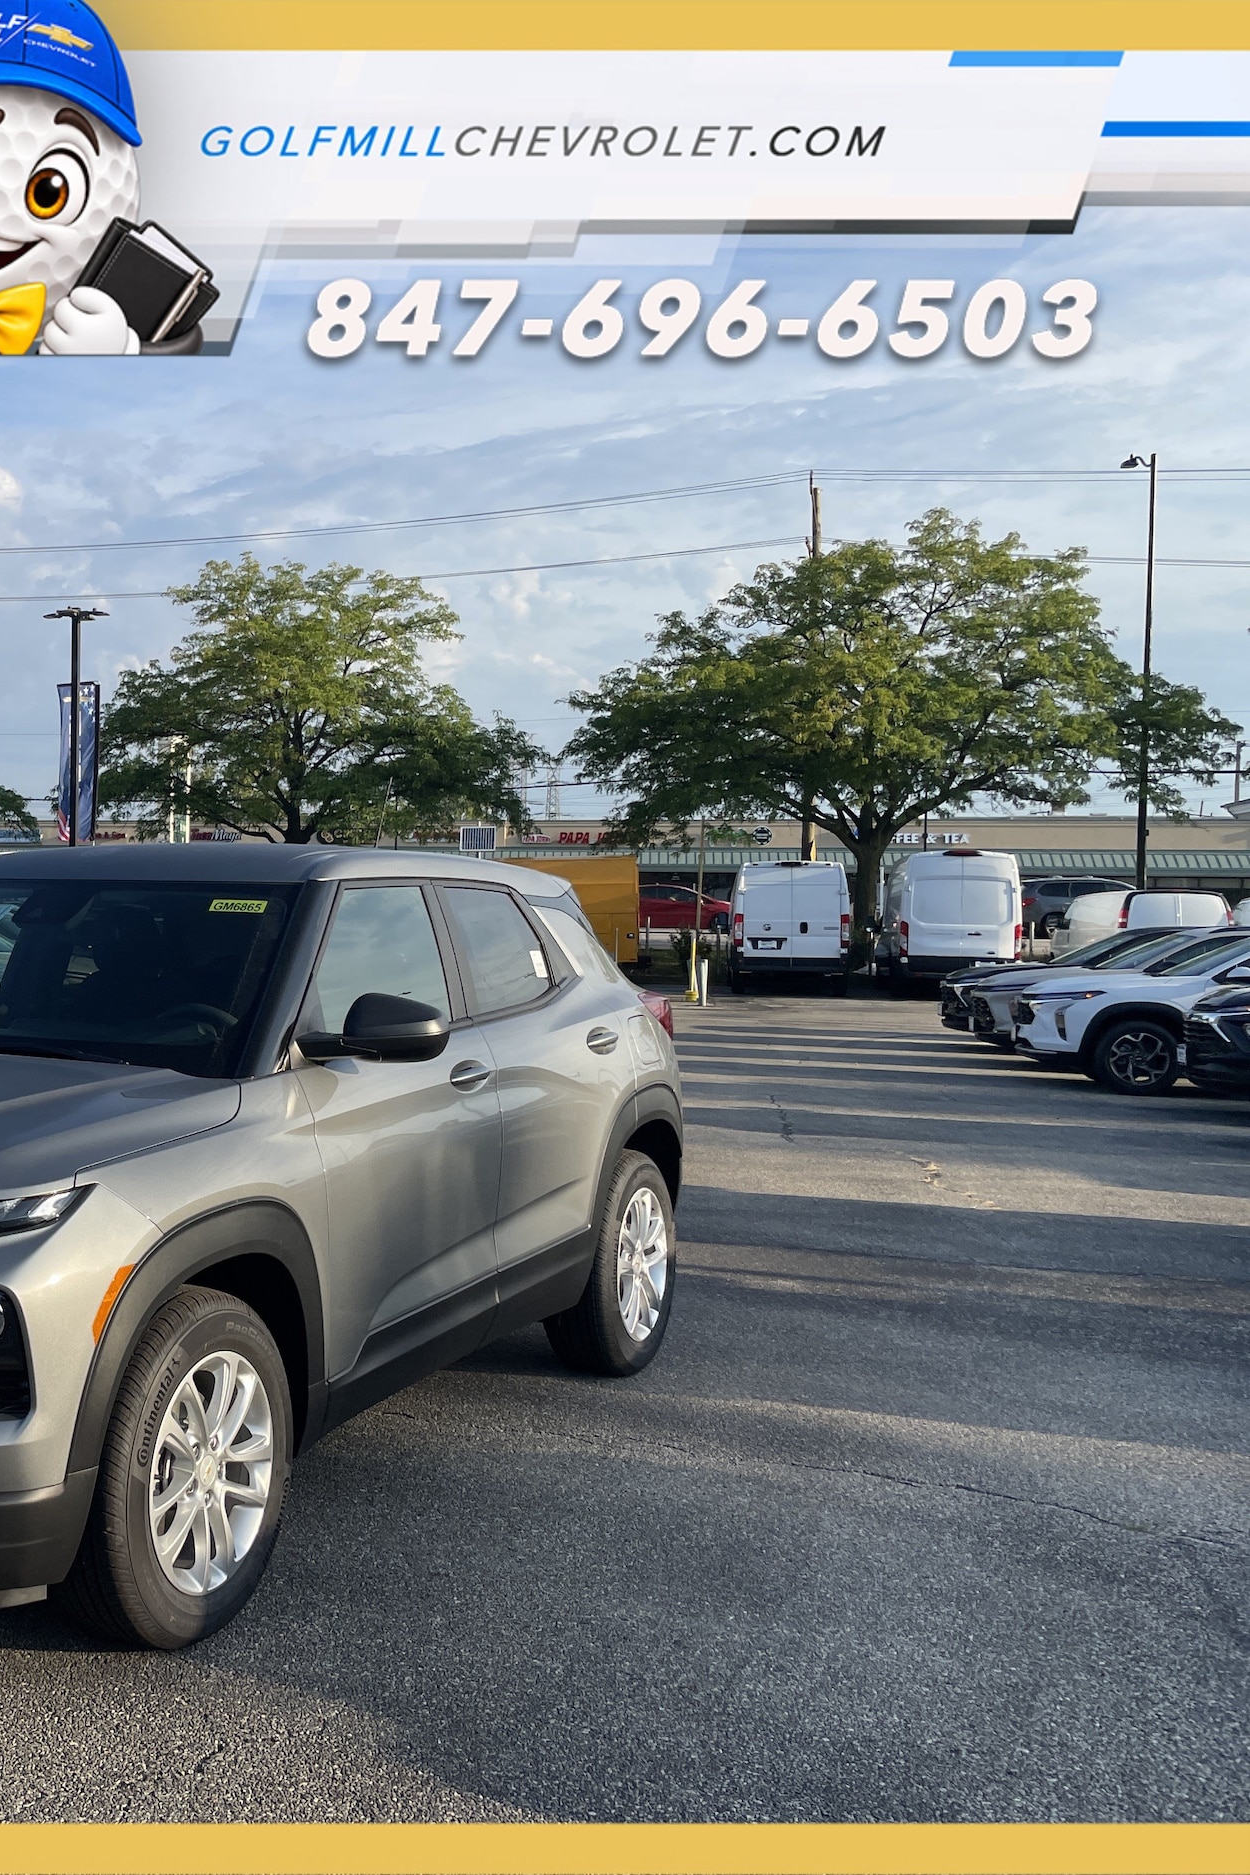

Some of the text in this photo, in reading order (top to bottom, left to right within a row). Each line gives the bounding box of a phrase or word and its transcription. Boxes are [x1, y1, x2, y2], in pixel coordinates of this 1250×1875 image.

[557, 832, 590, 844] PAPA
[890, 833, 920, 844] FFEE
[943, 833, 969, 844] TEA
[213, 901, 262, 912] GM6865
